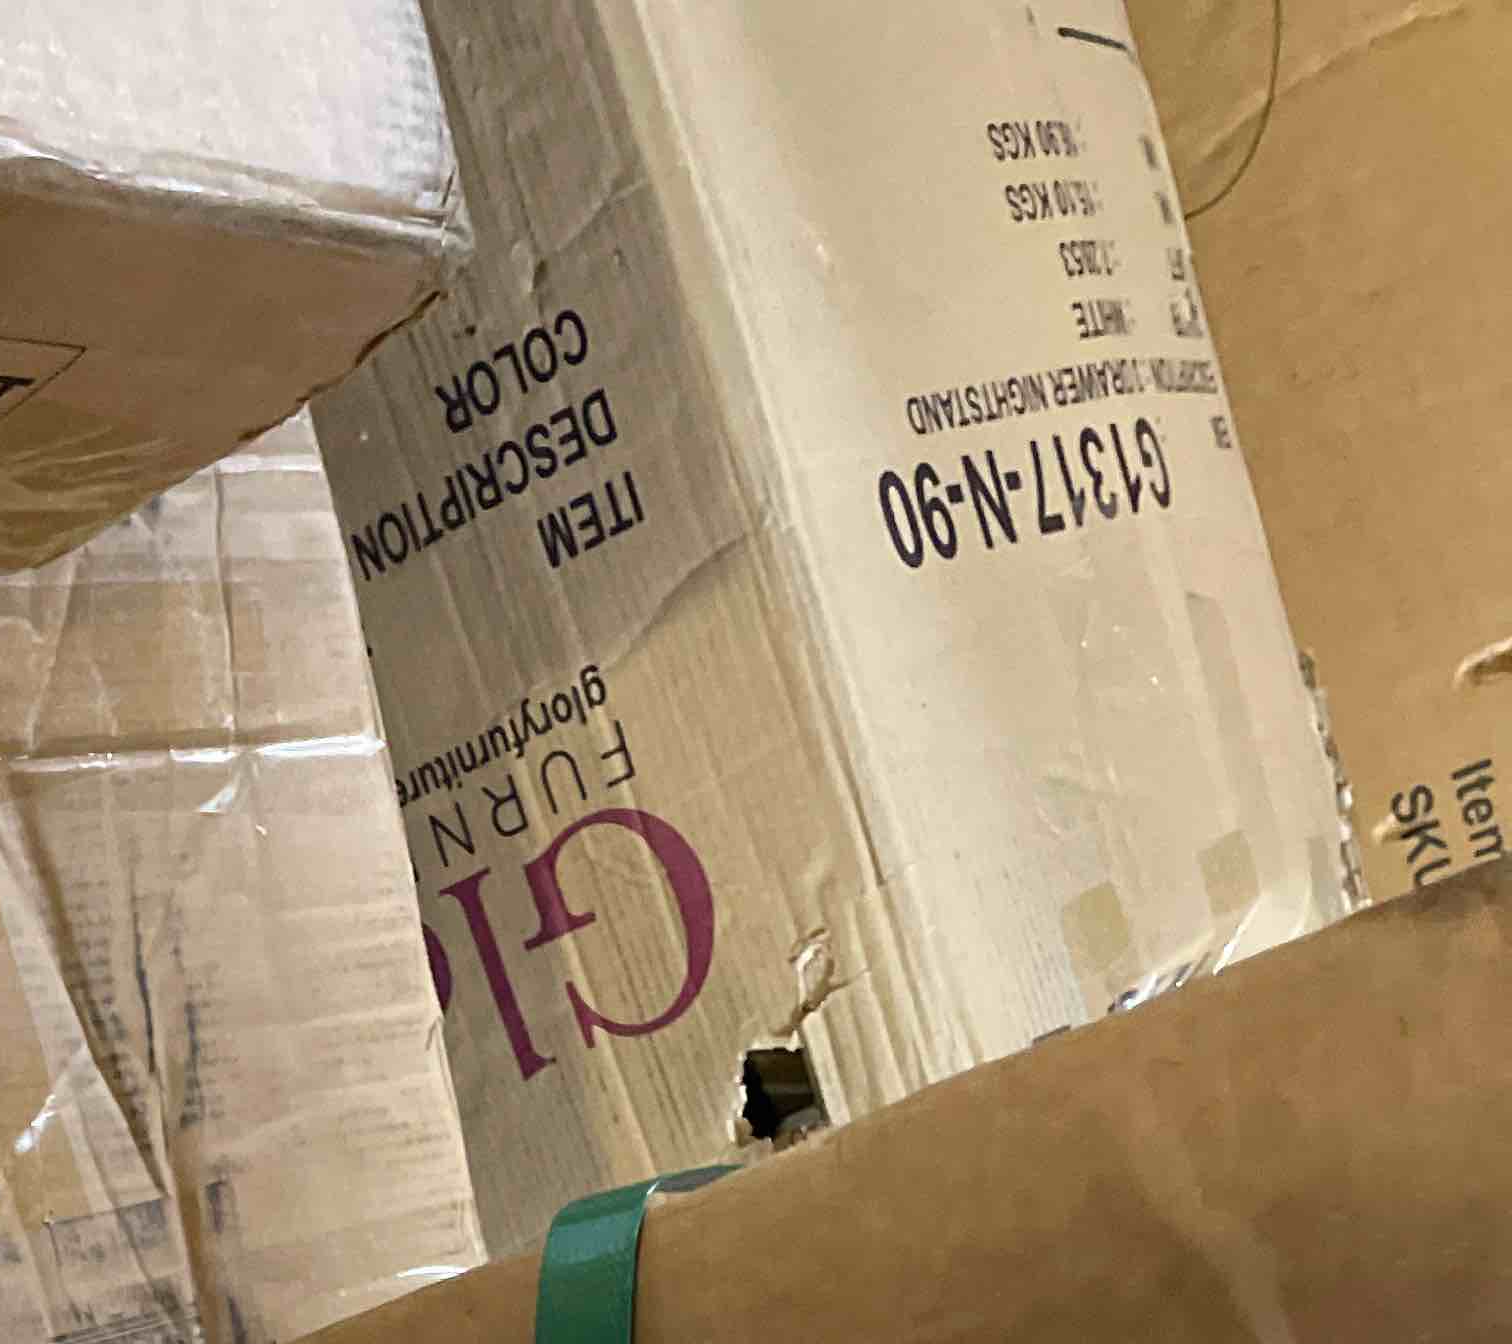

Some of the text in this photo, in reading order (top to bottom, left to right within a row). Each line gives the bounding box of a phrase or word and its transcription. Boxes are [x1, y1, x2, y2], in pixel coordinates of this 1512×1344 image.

[986, 120, 1036, 161] KGS
[1004, 182, 1053, 222] KGS
[434, 309, 588, 434] COLOR
[905, 370, 1050, 435] NIGHTSTAND
[350, 387, 619, 582] DESCRIPTION
[537, 470, 645, 568] ITEM
[877, 416, 1172, 569] G1317-N-90
[412, 720, 637, 882] FURN
